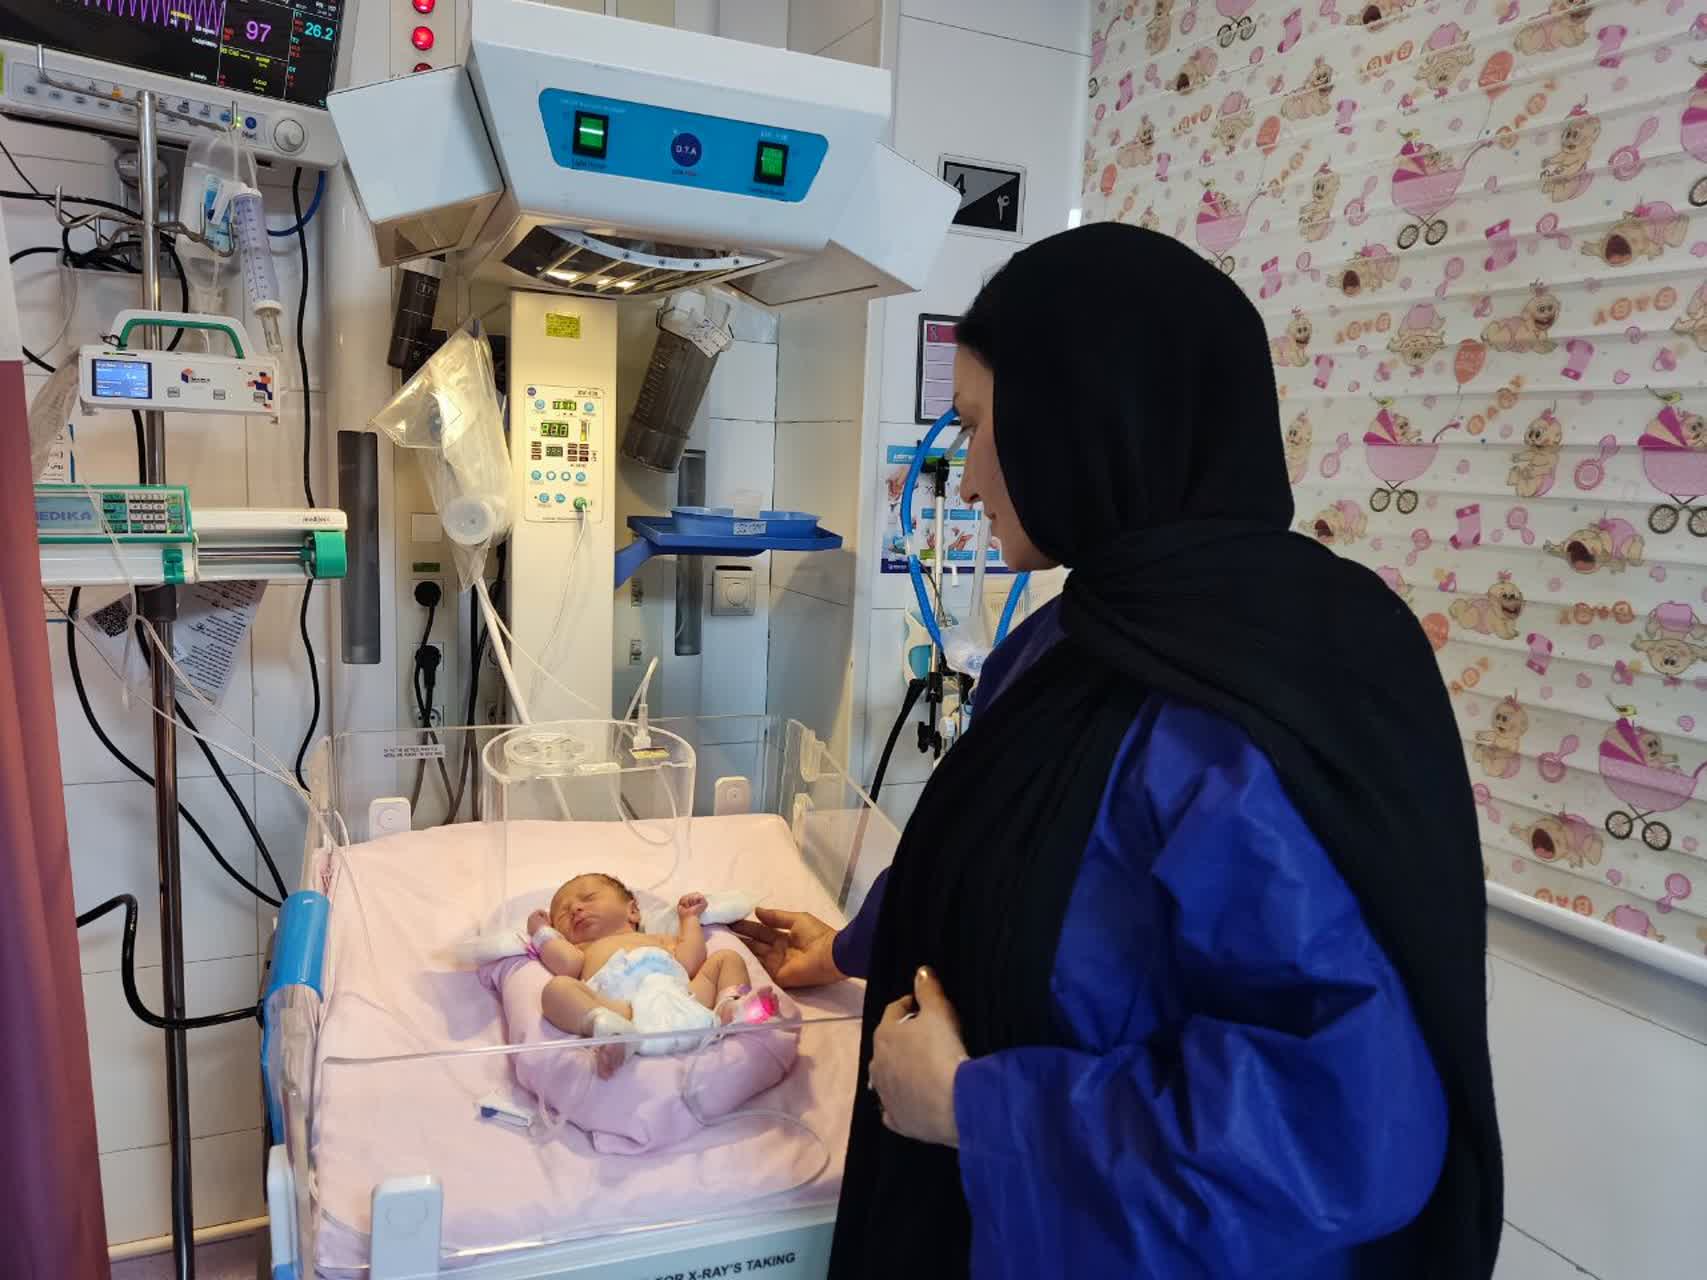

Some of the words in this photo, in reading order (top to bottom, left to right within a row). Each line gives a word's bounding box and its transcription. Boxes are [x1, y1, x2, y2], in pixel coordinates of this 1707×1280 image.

[245, 20, 272, 43] 97
[304, 22, 334, 41] 26.2
[953, 173, 967, 197] 4
[688, 1262, 742, 1280] X-RAY'S
[746, 1252, 796, 1271] TAKING
